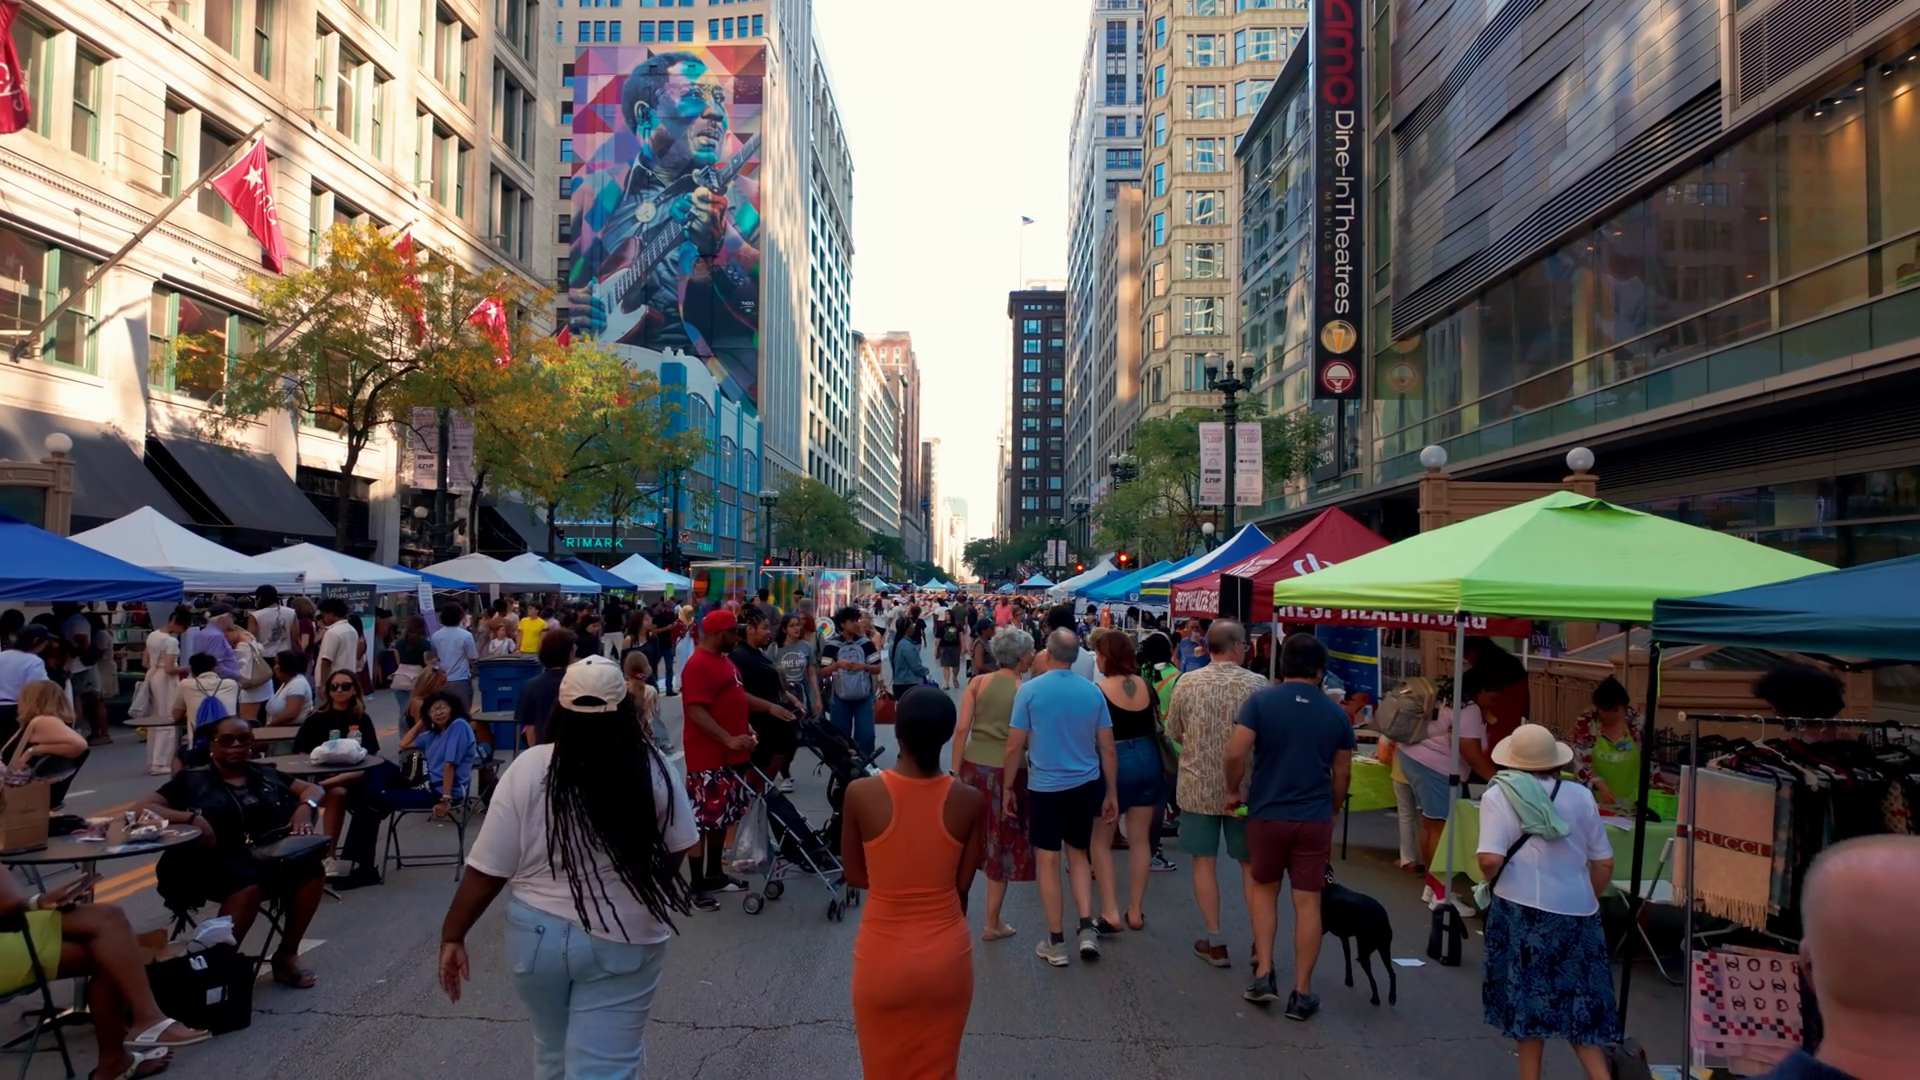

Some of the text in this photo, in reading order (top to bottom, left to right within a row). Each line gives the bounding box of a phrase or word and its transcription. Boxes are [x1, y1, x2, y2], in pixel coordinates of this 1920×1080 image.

[1322, 0, 1356, 105] amc
[1324, 110, 1332, 176] MOVIES
[1324, 191, 1332, 252] MENUS
[566, 537, 624, 548] RIMARK
[1694, 828, 1763, 856] GUCCI
